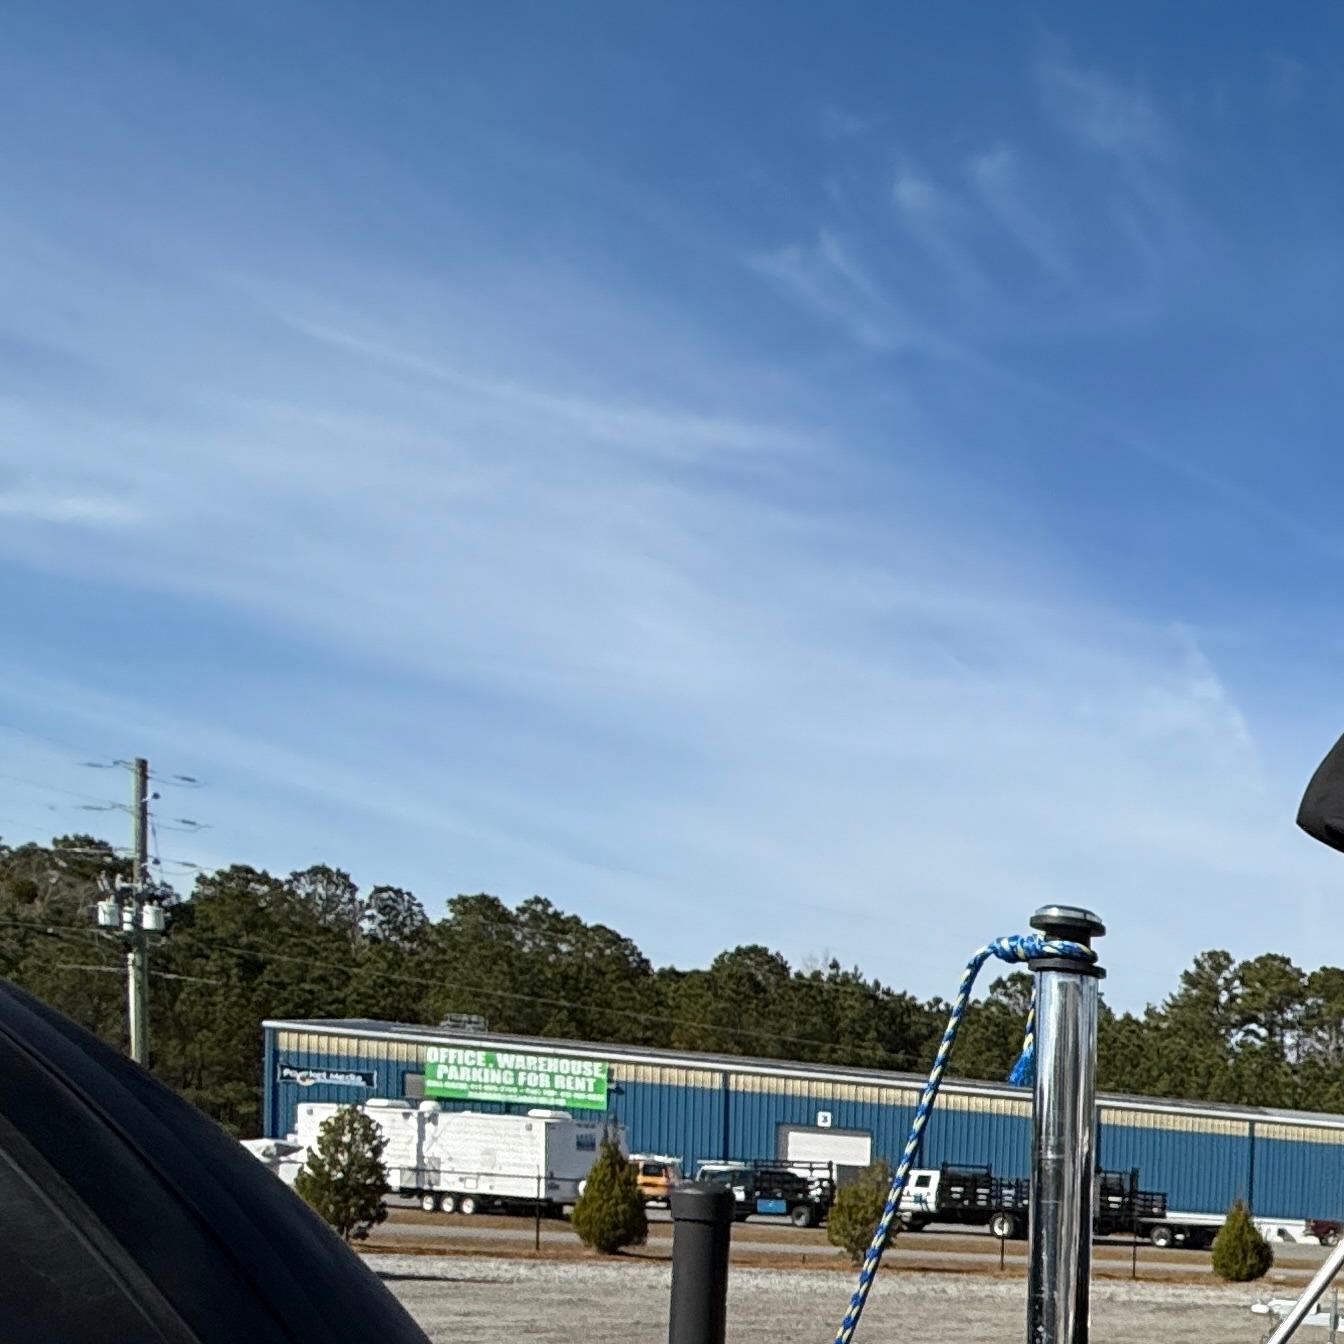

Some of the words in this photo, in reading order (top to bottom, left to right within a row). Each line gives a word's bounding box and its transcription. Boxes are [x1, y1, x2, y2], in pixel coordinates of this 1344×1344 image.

[437, 1064, 514, 1085] PARKING
[518, 1072, 549, 1088] FOR
[555, 1075, 595, 1093] RENT
